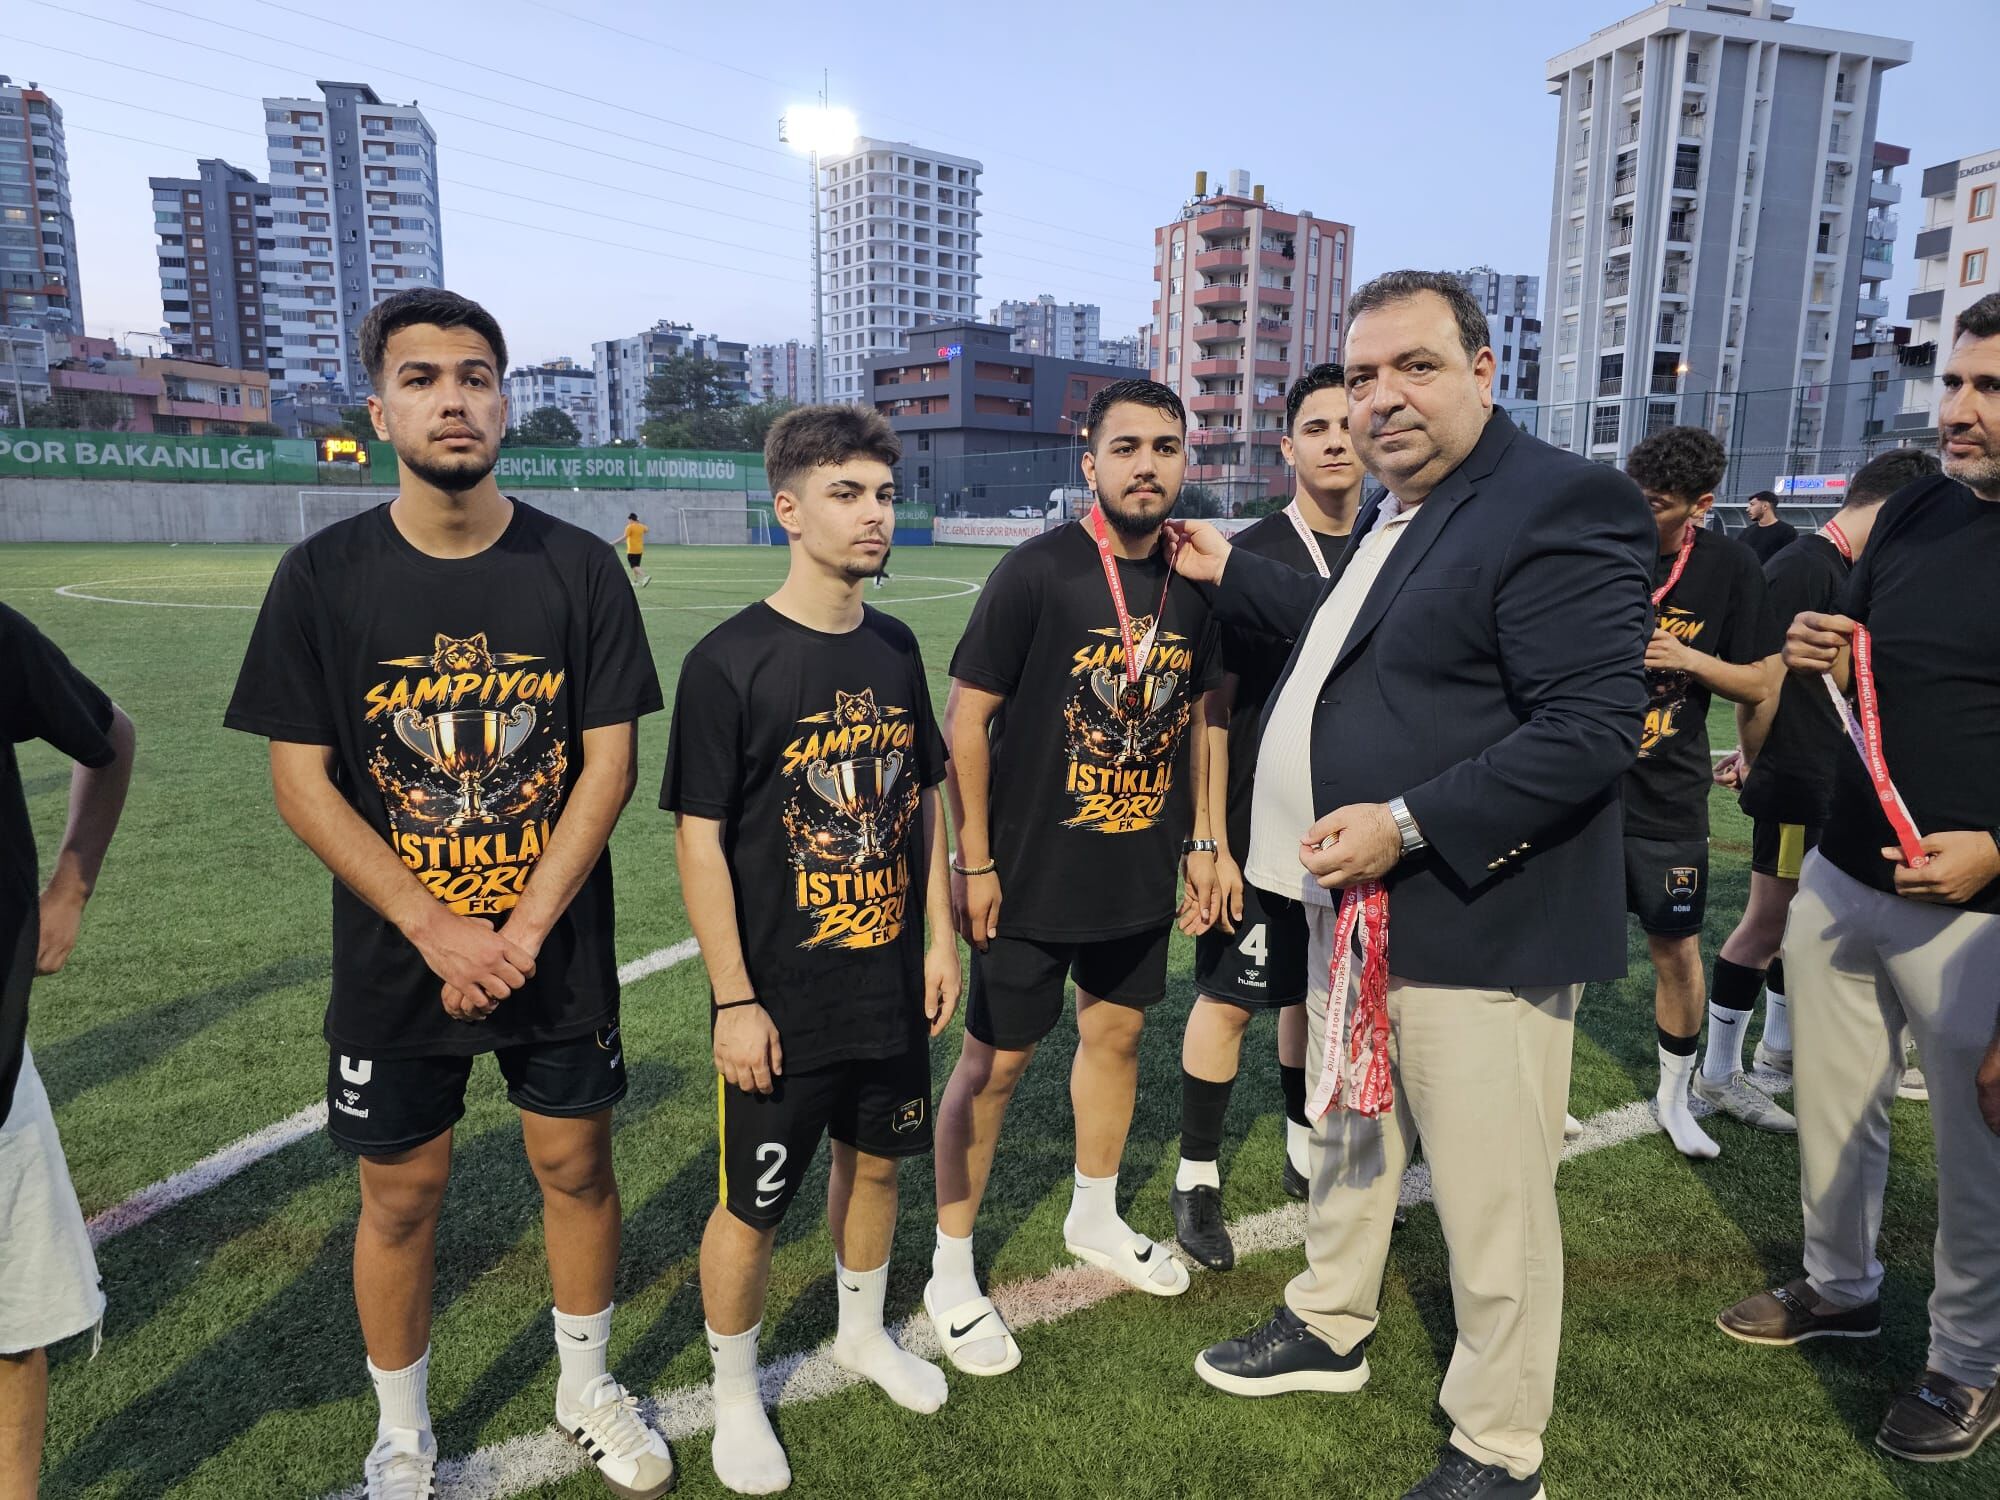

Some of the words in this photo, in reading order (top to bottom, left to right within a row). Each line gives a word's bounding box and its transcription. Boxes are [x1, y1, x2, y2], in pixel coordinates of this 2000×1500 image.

[75, 442, 265, 470] BAKANLIĞI
[561, 459, 582, 477] VE
[585, 459, 625, 476] SPOR
[629, 456, 643, 477] İL
[647, 457, 735, 479] MÜDÜRLÜĞÜ
[986, 526, 1004, 537] SPOR
[1070, 640, 1193, 677] SAMİYON
[1865, 708, 1873, 719] VE
[1867, 719, 1877, 740] SPOR
[1870, 740, 1886, 783] BAKANLIĞI
[1118, 820, 1133, 831] FK
[468, 899, 498, 912] FK
[1238, 923, 1268, 966] 4
[1237, 976, 1267, 988] hummel
[335, 1098, 369, 1118] hummel
[756, 1142, 788, 1192] 2
